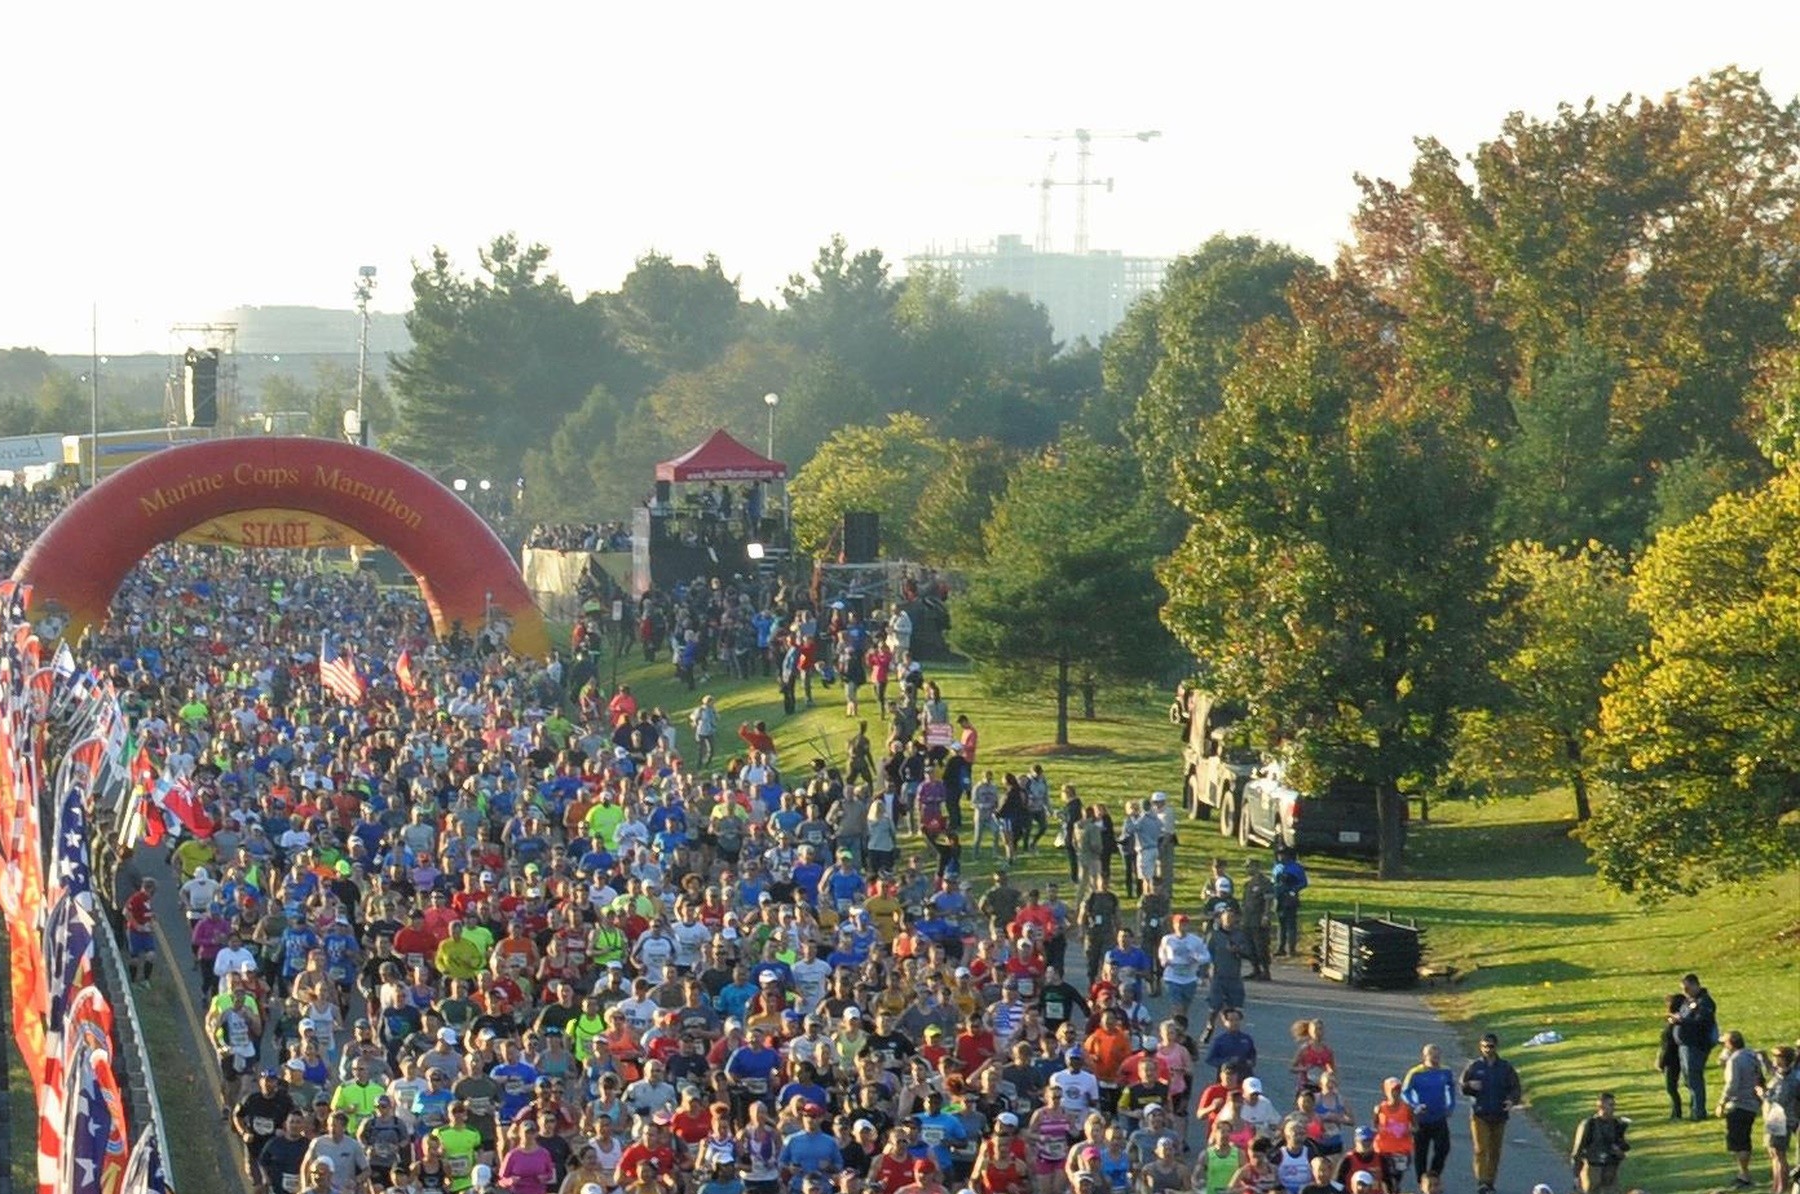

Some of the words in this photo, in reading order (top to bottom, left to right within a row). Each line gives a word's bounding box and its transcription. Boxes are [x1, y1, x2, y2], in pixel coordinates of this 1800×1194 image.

[139, 472, 224, 518] Marine
[233, 463, 300, 489] Corps
[314, 464, 423, 529] Marathon
[241, 520, 311, 547] START
